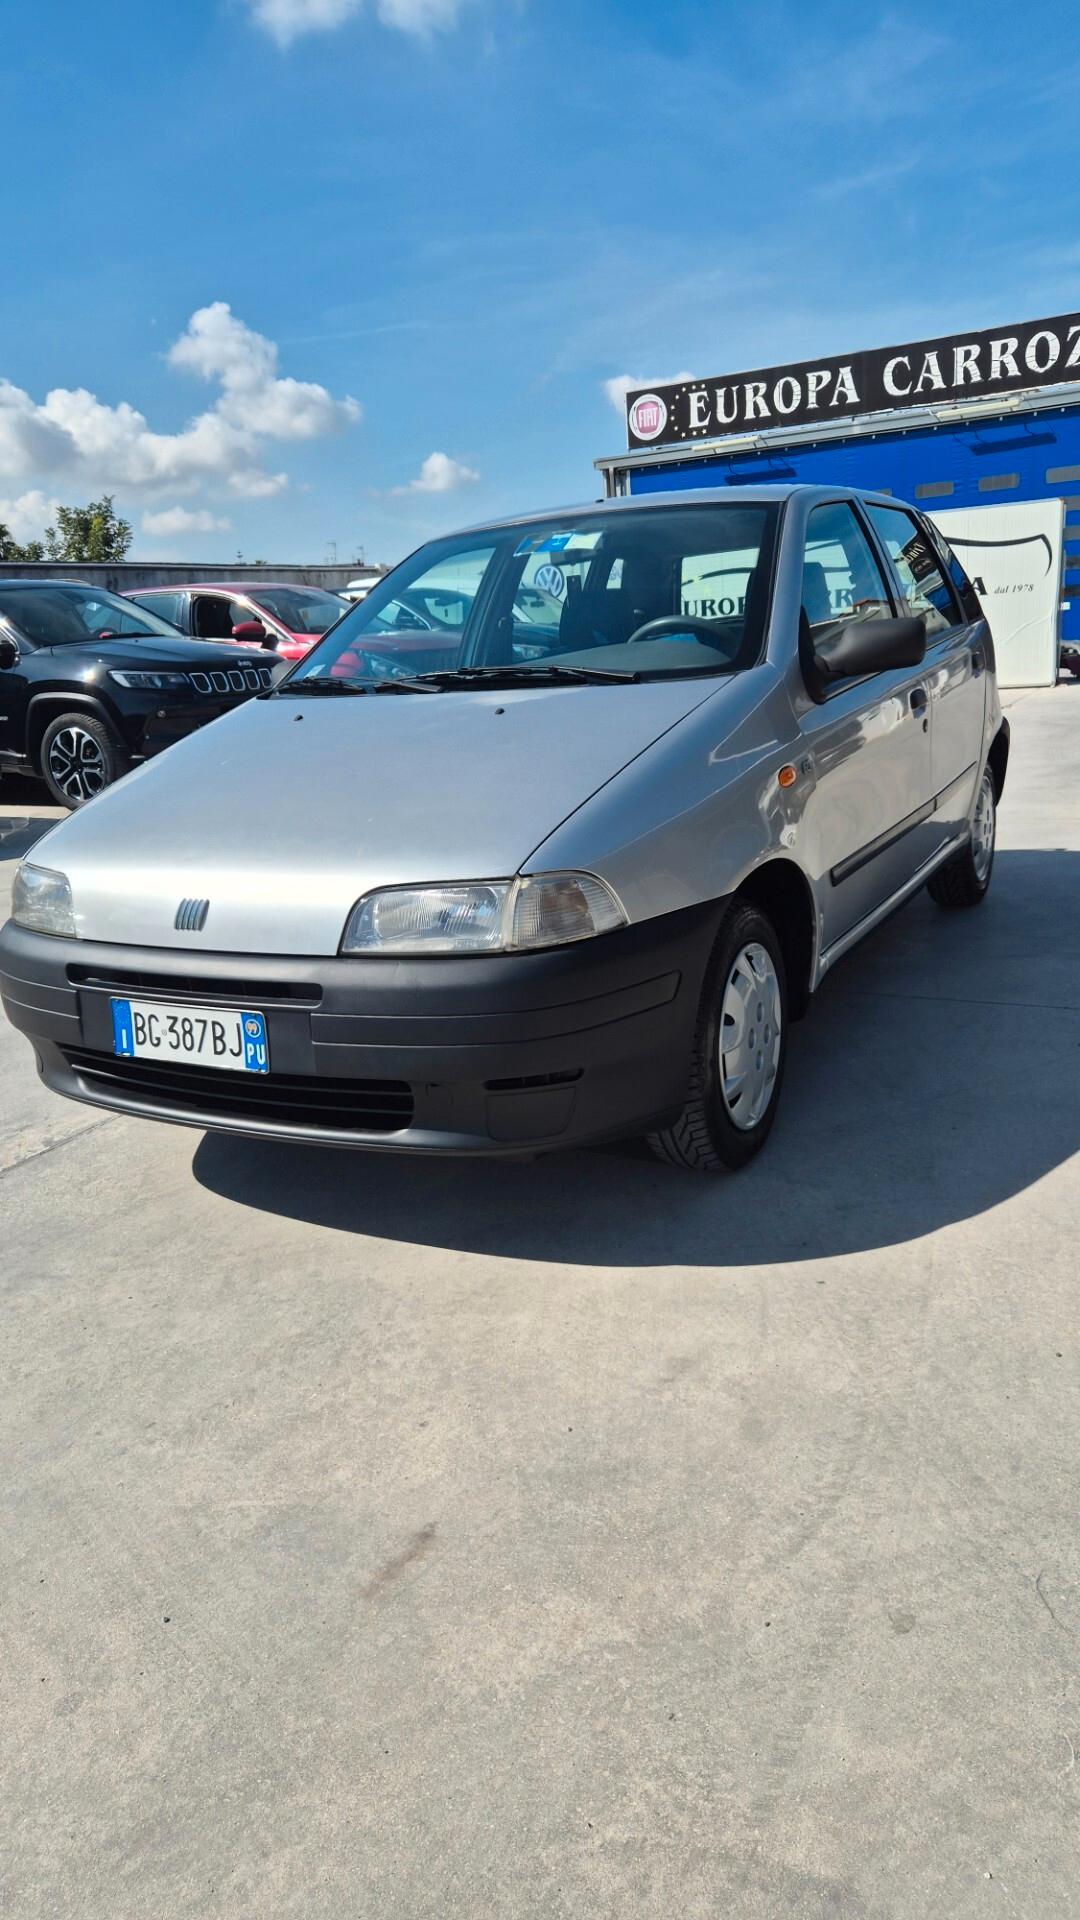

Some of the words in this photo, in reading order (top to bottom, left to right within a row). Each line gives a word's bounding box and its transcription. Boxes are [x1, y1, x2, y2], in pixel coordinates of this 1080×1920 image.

[688, 366, 860, 429] EUROPA
[638, 408, 658, 428] FIAT
[1012, 584, 1034, 593] 1978
[247, 1043, 265, 1065] PU
